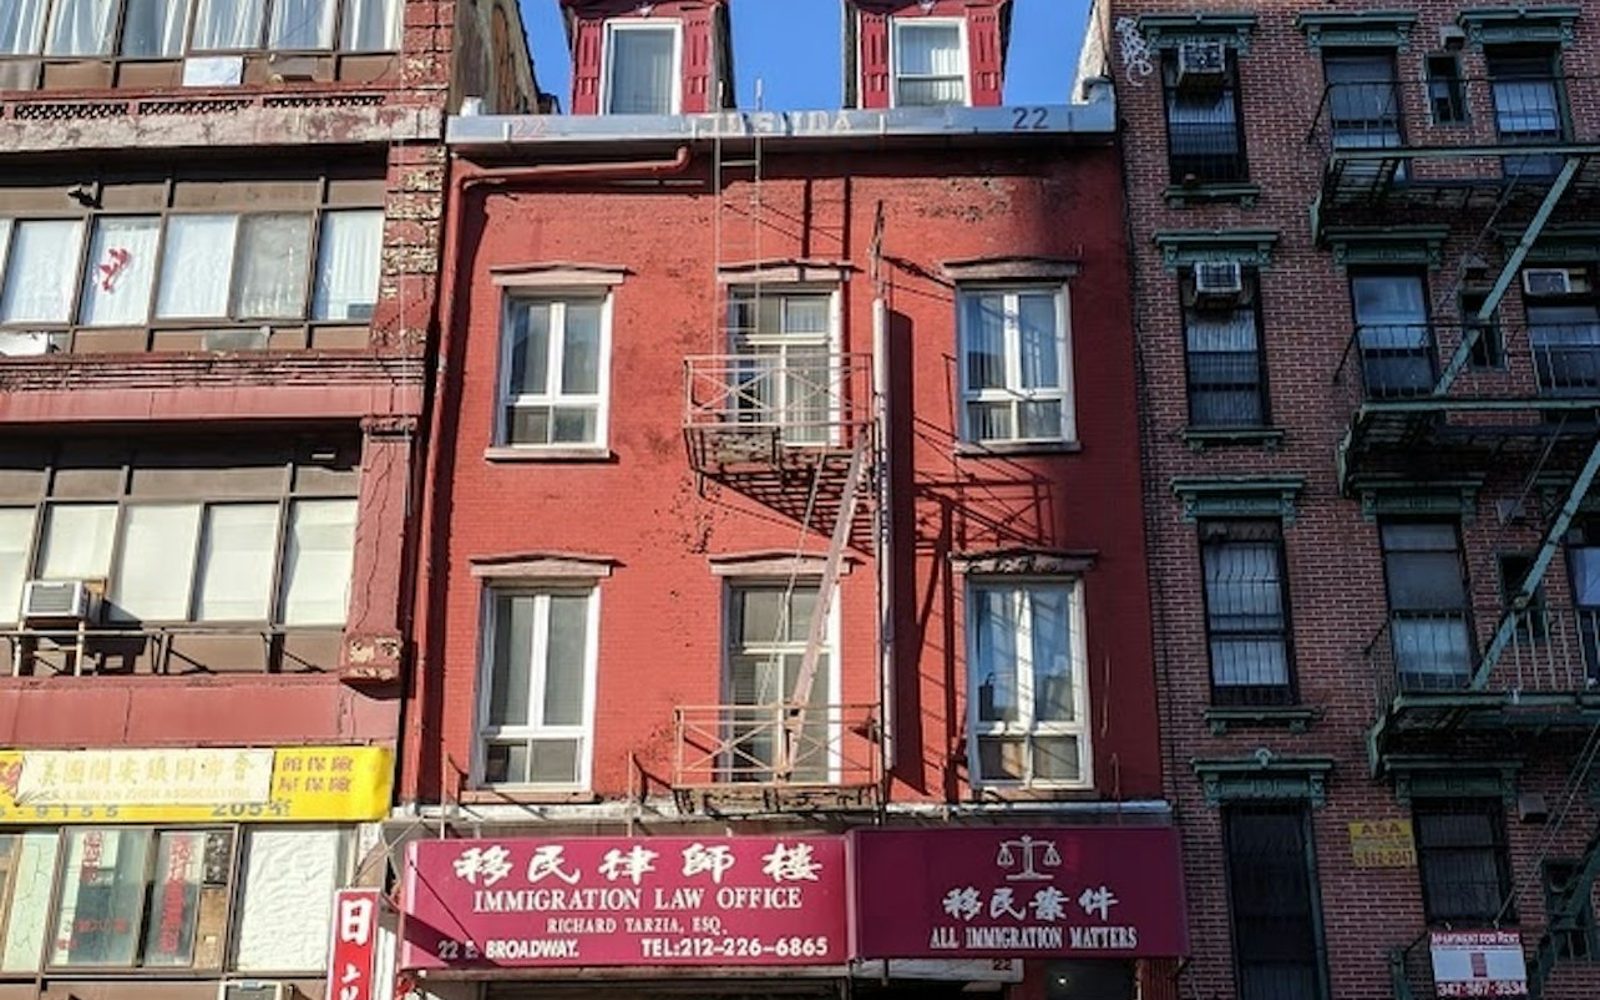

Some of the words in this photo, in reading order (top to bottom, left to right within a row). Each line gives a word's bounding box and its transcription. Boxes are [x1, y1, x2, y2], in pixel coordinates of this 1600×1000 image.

[1012, 107, 1048, 129] 22
[474, 888, 640, 912] IMMIGRATION
[655, 888, 704, 909] LAW
[716, 887, 802, 908] OFFICE
[547, 917, 617, 933] RICHARD
[641, 937, 828, 957] TEL:212-226-6865
[930, 927, 958, 948] ALL
[966, 927, 1063, 948] IMMIGRATION
[1070, 927, 1137, 948] MATTERS
[438, 940, 458, 958] 22
[486, 940, 580, 958] BROADWAY.
